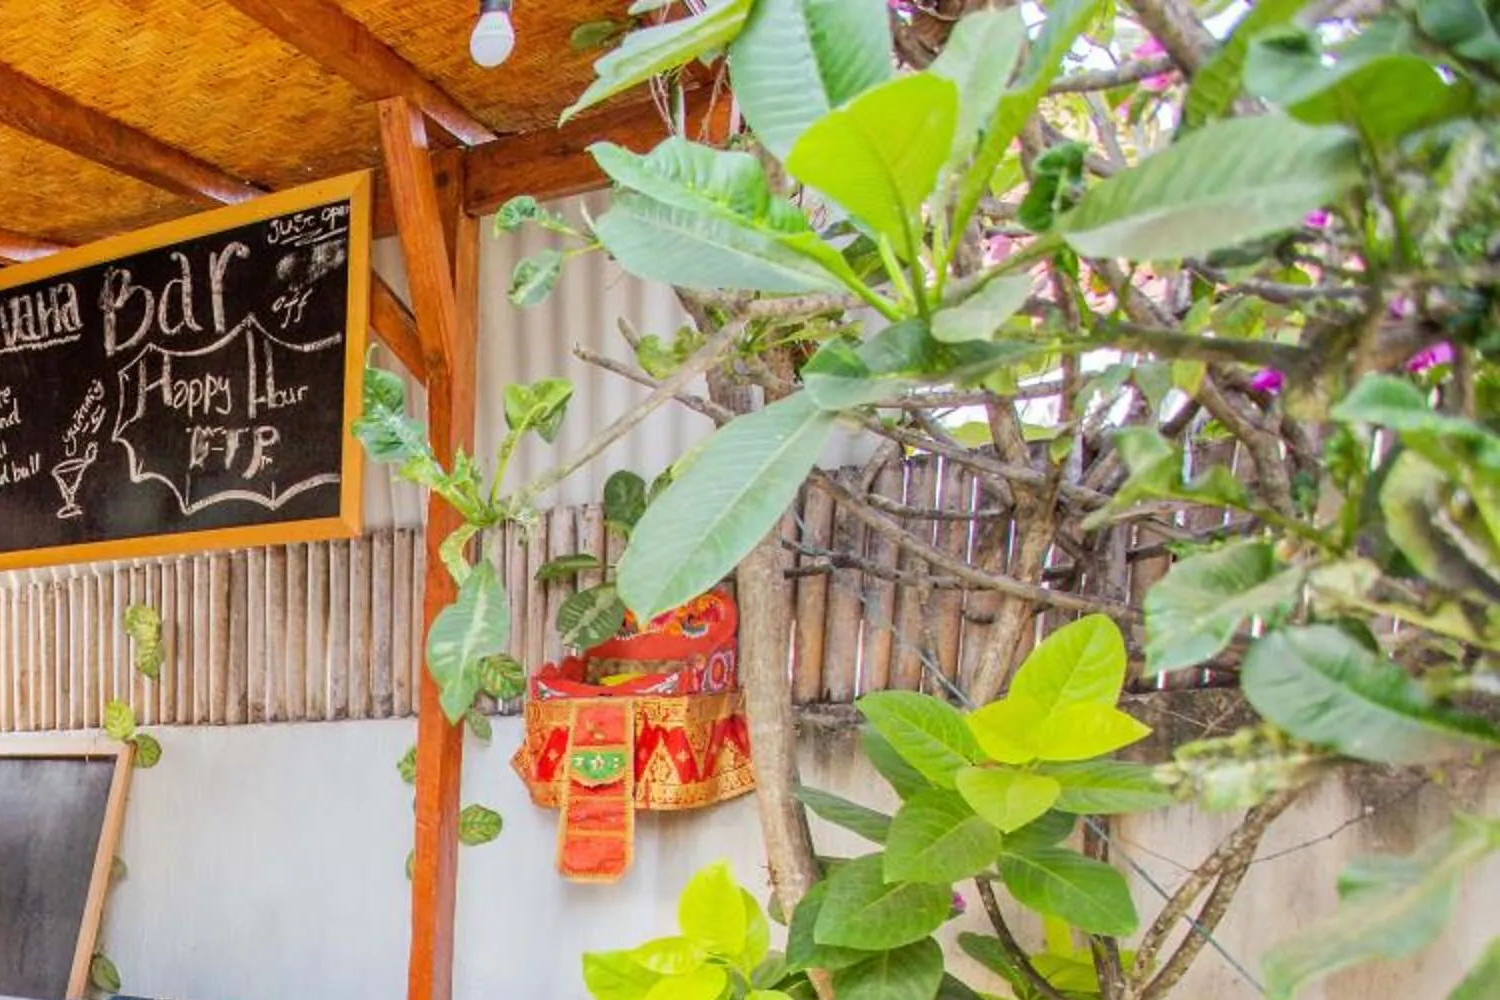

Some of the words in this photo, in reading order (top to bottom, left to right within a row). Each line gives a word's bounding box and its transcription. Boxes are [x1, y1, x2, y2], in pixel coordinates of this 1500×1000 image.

[100, 241, 250, 357] Bar
[136, 352, 232, 419] Happy
[247, 330, 309, 419] Hour
